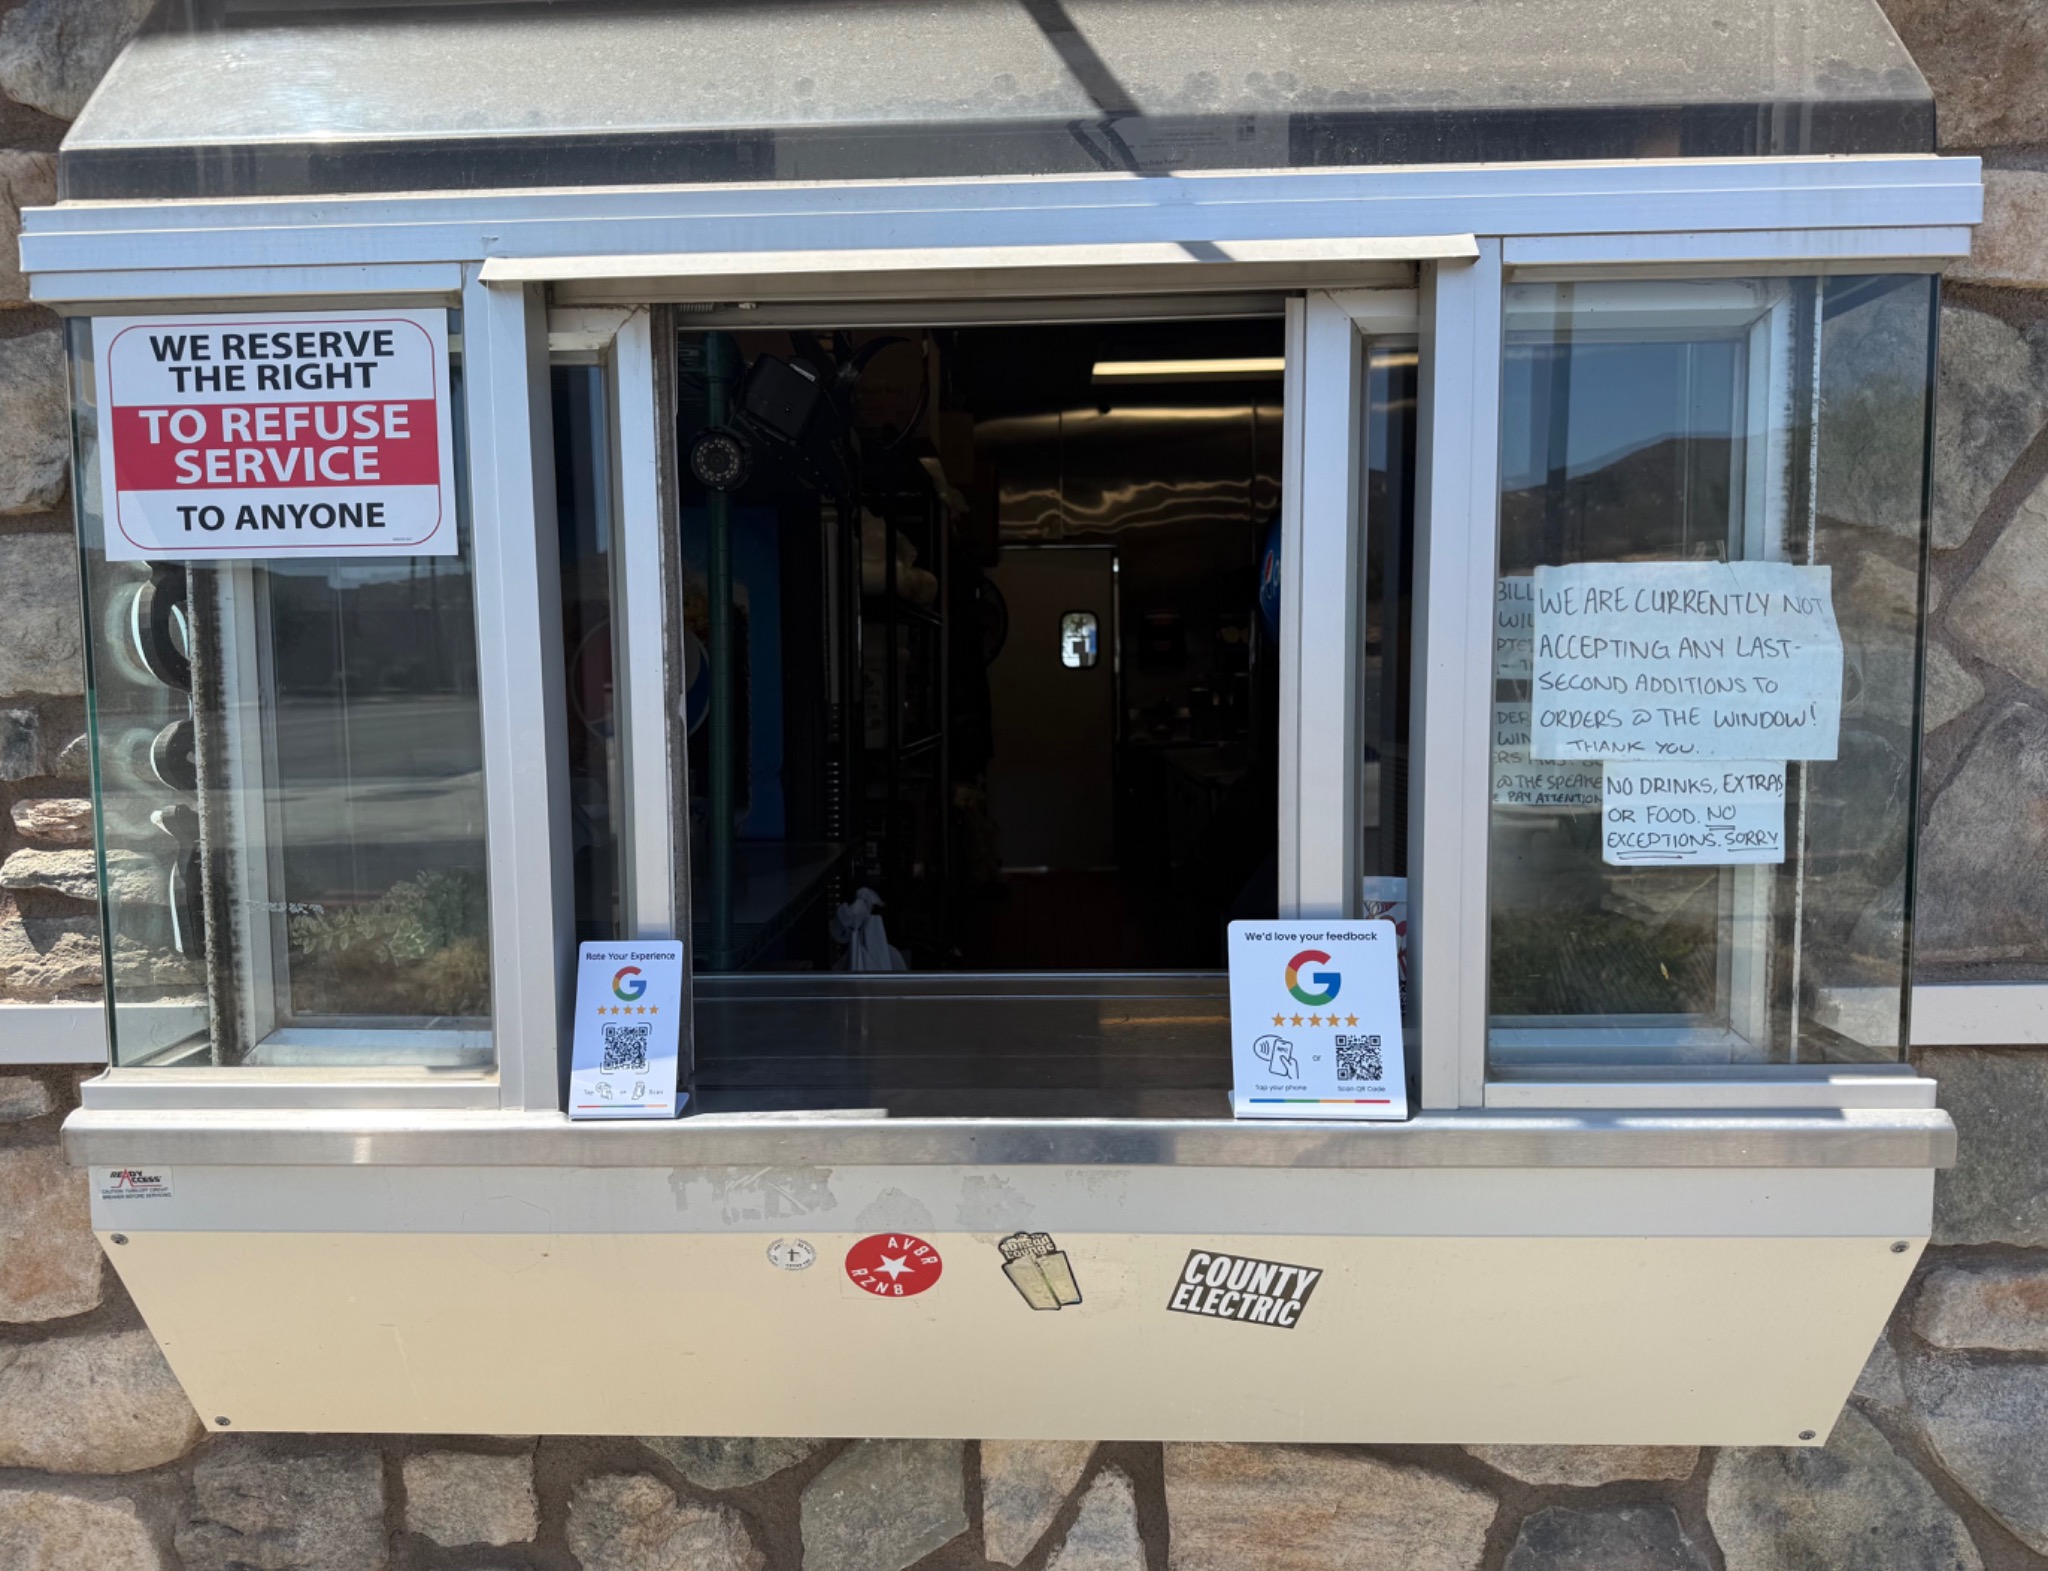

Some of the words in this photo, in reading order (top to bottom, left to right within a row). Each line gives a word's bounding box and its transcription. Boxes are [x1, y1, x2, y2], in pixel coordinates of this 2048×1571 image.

[150, 334, 210, 362] WE
[222, 330, 394, 360] RESERVE
[169, 365, 246, 393] THE
[257, 362, 378, 391] RIGHT
[138, 409, 207, 444] TO
[222, 405, 411, 443] REFUSE
[175, 446, 380, 484] SERVICE
[177, 505, 225, 531] TO
[235, 502, 386, 531] ANYONE
[1540, 587, 1578, 615] WE
[1584, 586, 1629, 615] ARE
[1635, 588, 1770, 616] CURRENTLY
[1783, 594, 1823, 616] NOT
[1539, 634, 1670, 659] ACCEPTING
[1679, 636, 1723, 659] ANY
[1736, 636, 1801, 659] LAST-
[1539, 671, 1628, 694] SECOND
[1635, 673, 1747, 695] ADDITIONS
[1752, 676, 1779, 694] TO
[1540, 709, 1623, 729] ORDERS
[1632, 709, 1652, 726] @
[1656, 707, 1700, 727] THE
[1714, 701, 1817, 729] WINDOW!
[1566, 739, 1645, 753] THANK
[1515, 774, 1543, 789] THE
[1607, 776, 1633, 795] NO
[1640, 777, 1718, 795] DRINKS,
[1507, 791, 1531, 802] PAY
[1608, 807, 1636, 823] OR
[1647, 805, 1701, 824] FOOD.
[1706, 804, 1736, 821] NO
[1724, 829, 1779, 846] SORRY
[1244, 932, 1272, 941] We'd
[1274, 932, 1297, 941] love
[1300, 934, 1324, 944] your
[1326, 931, 1378, 941] feedback
[586, 952, 606, 961] Rate
[608, 952, 629, 961] Your
[630, 951, 676, 963] Experience
[1184, 1253, 1319, 1300] COUNTY
[1171, 1283, 1300, 1326] ELECTRIC
